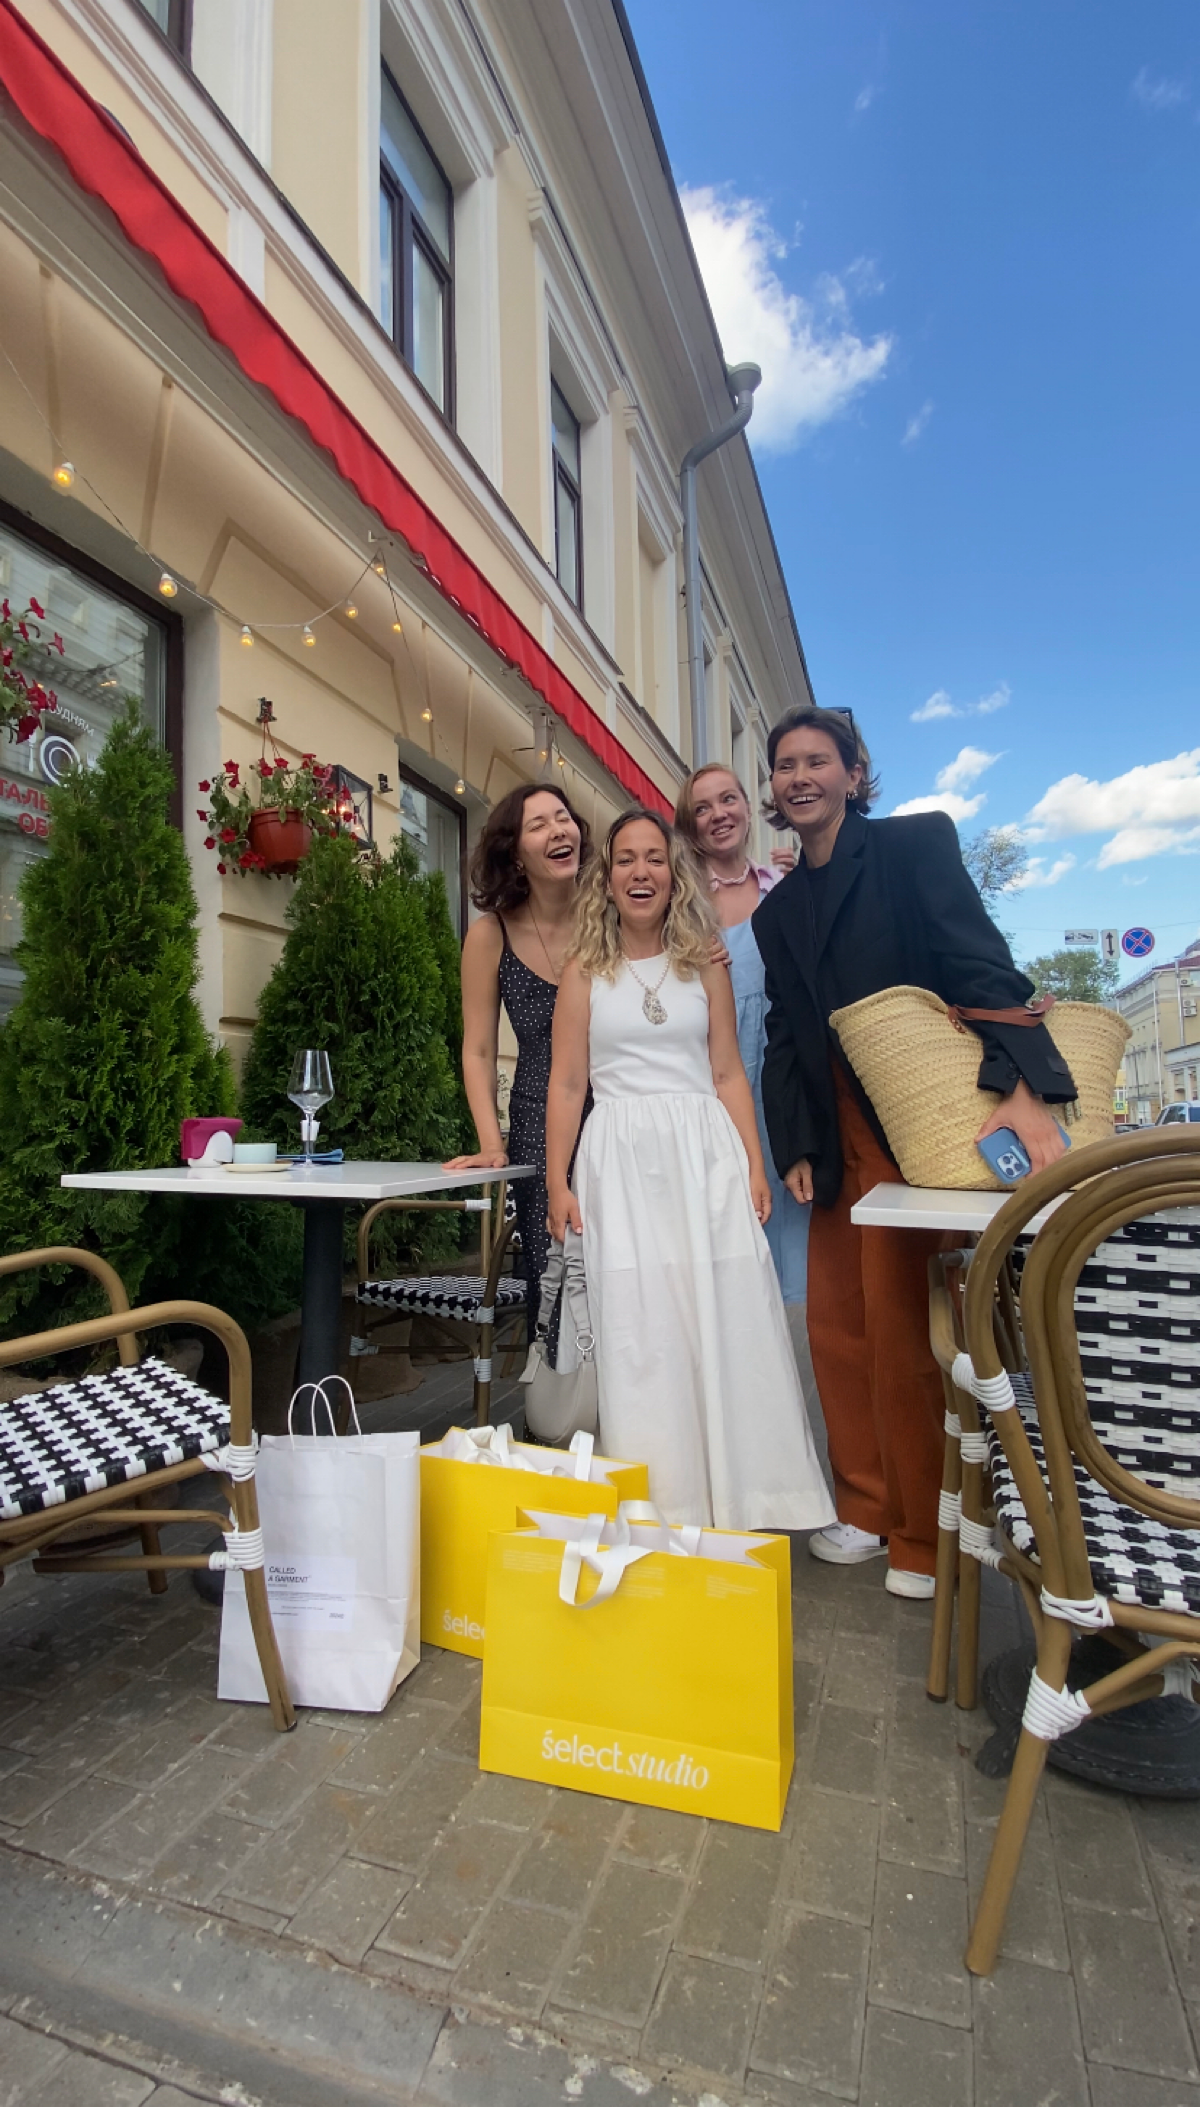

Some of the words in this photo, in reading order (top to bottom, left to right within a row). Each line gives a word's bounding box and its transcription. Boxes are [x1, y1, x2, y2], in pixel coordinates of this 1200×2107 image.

[18, 812, 51, 838] ОБ
[269, 1566, 296, 1574] CALLED
[275, 1575, 308, 1583] GARMENT
